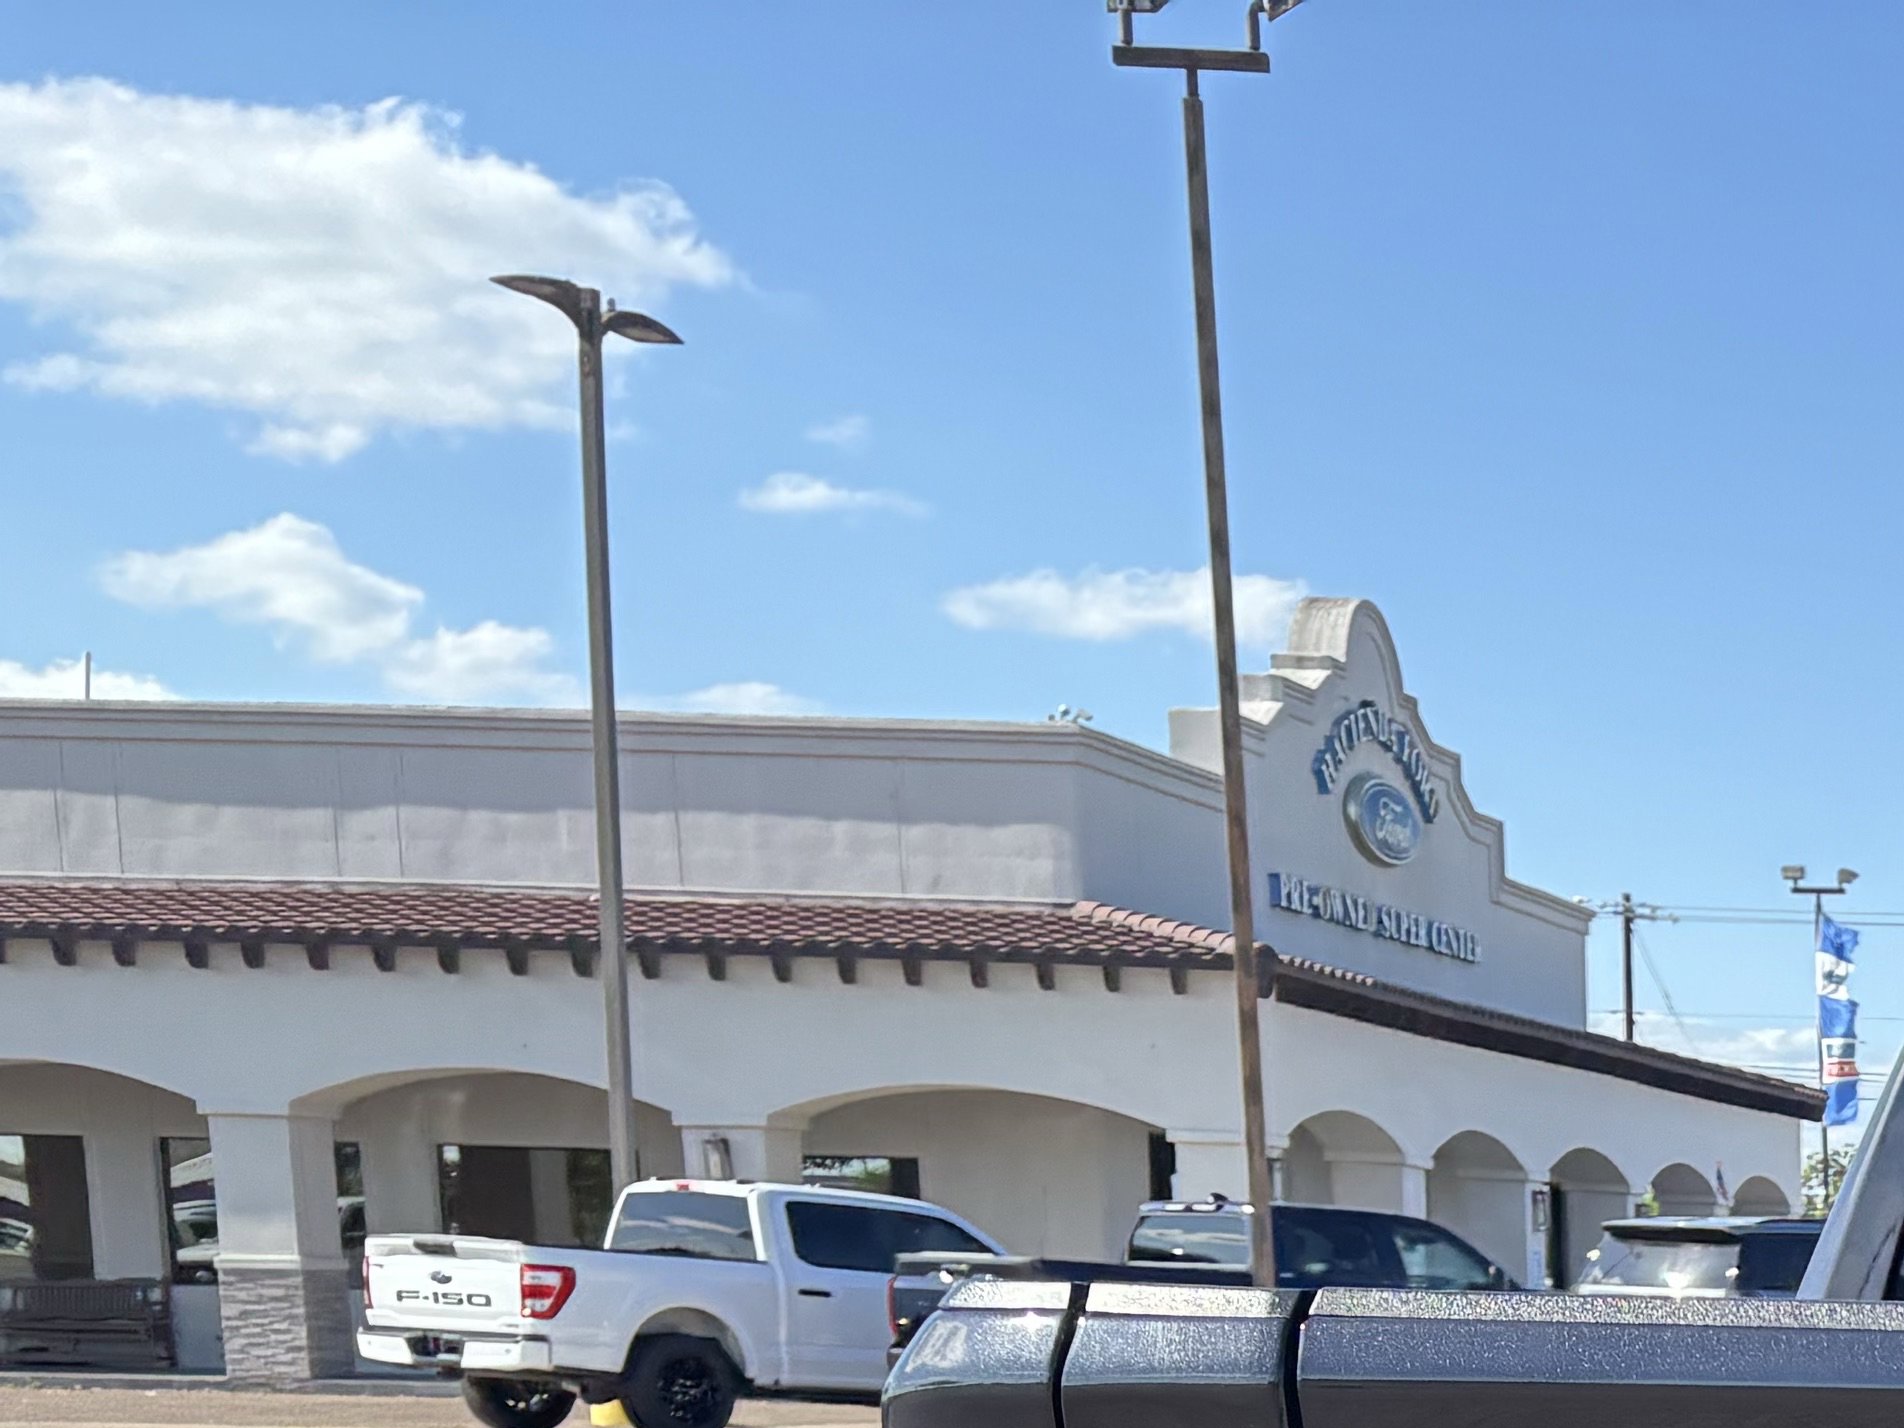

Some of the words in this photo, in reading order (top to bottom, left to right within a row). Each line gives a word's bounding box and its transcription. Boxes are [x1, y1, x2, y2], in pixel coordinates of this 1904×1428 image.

[1278, 872, 1378, 934] PRE-OWNED
[1380, 903, 1429, 948] SUPER
[1431, 919, 1483, 964] CENTER
[395, 1289, 492, 1308] F-150
